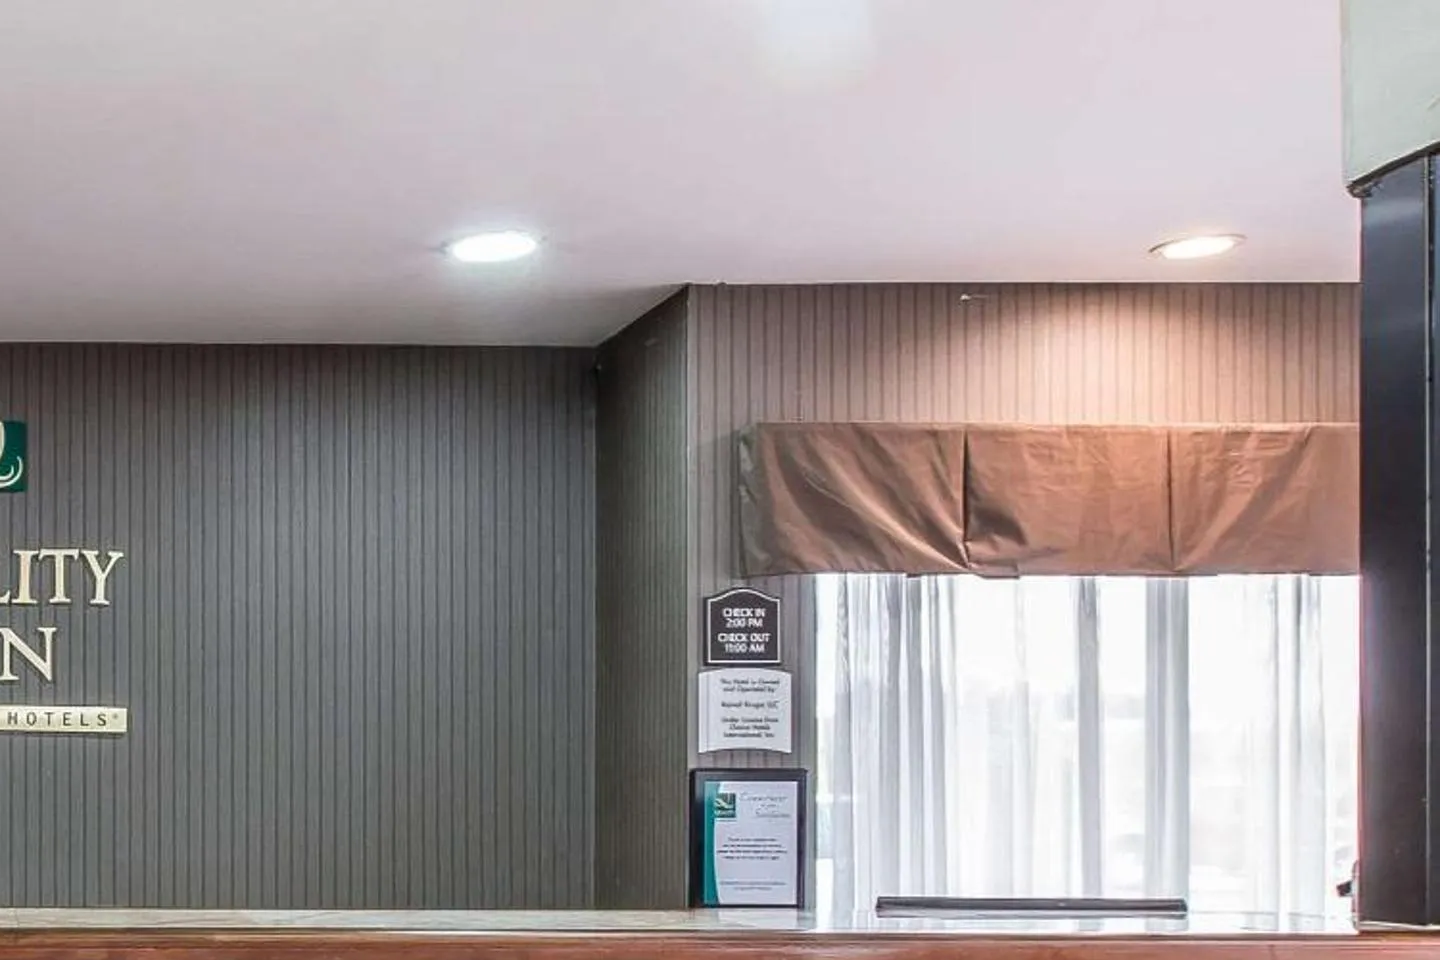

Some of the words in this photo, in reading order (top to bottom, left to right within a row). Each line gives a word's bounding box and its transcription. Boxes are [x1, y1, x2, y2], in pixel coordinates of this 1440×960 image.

[723, 608, 753, 618] CHECK
[755, 608, 766, 618] IN
[726, 618, 746, 628] 2:00
[748, 618, 764, 628] PM
[717, 632, 748, 643] CHECK
[750, 632, 772, 643] OUT
[749, 643, 765, 653] AM
[7, 710, 108, 727] HOTELS
